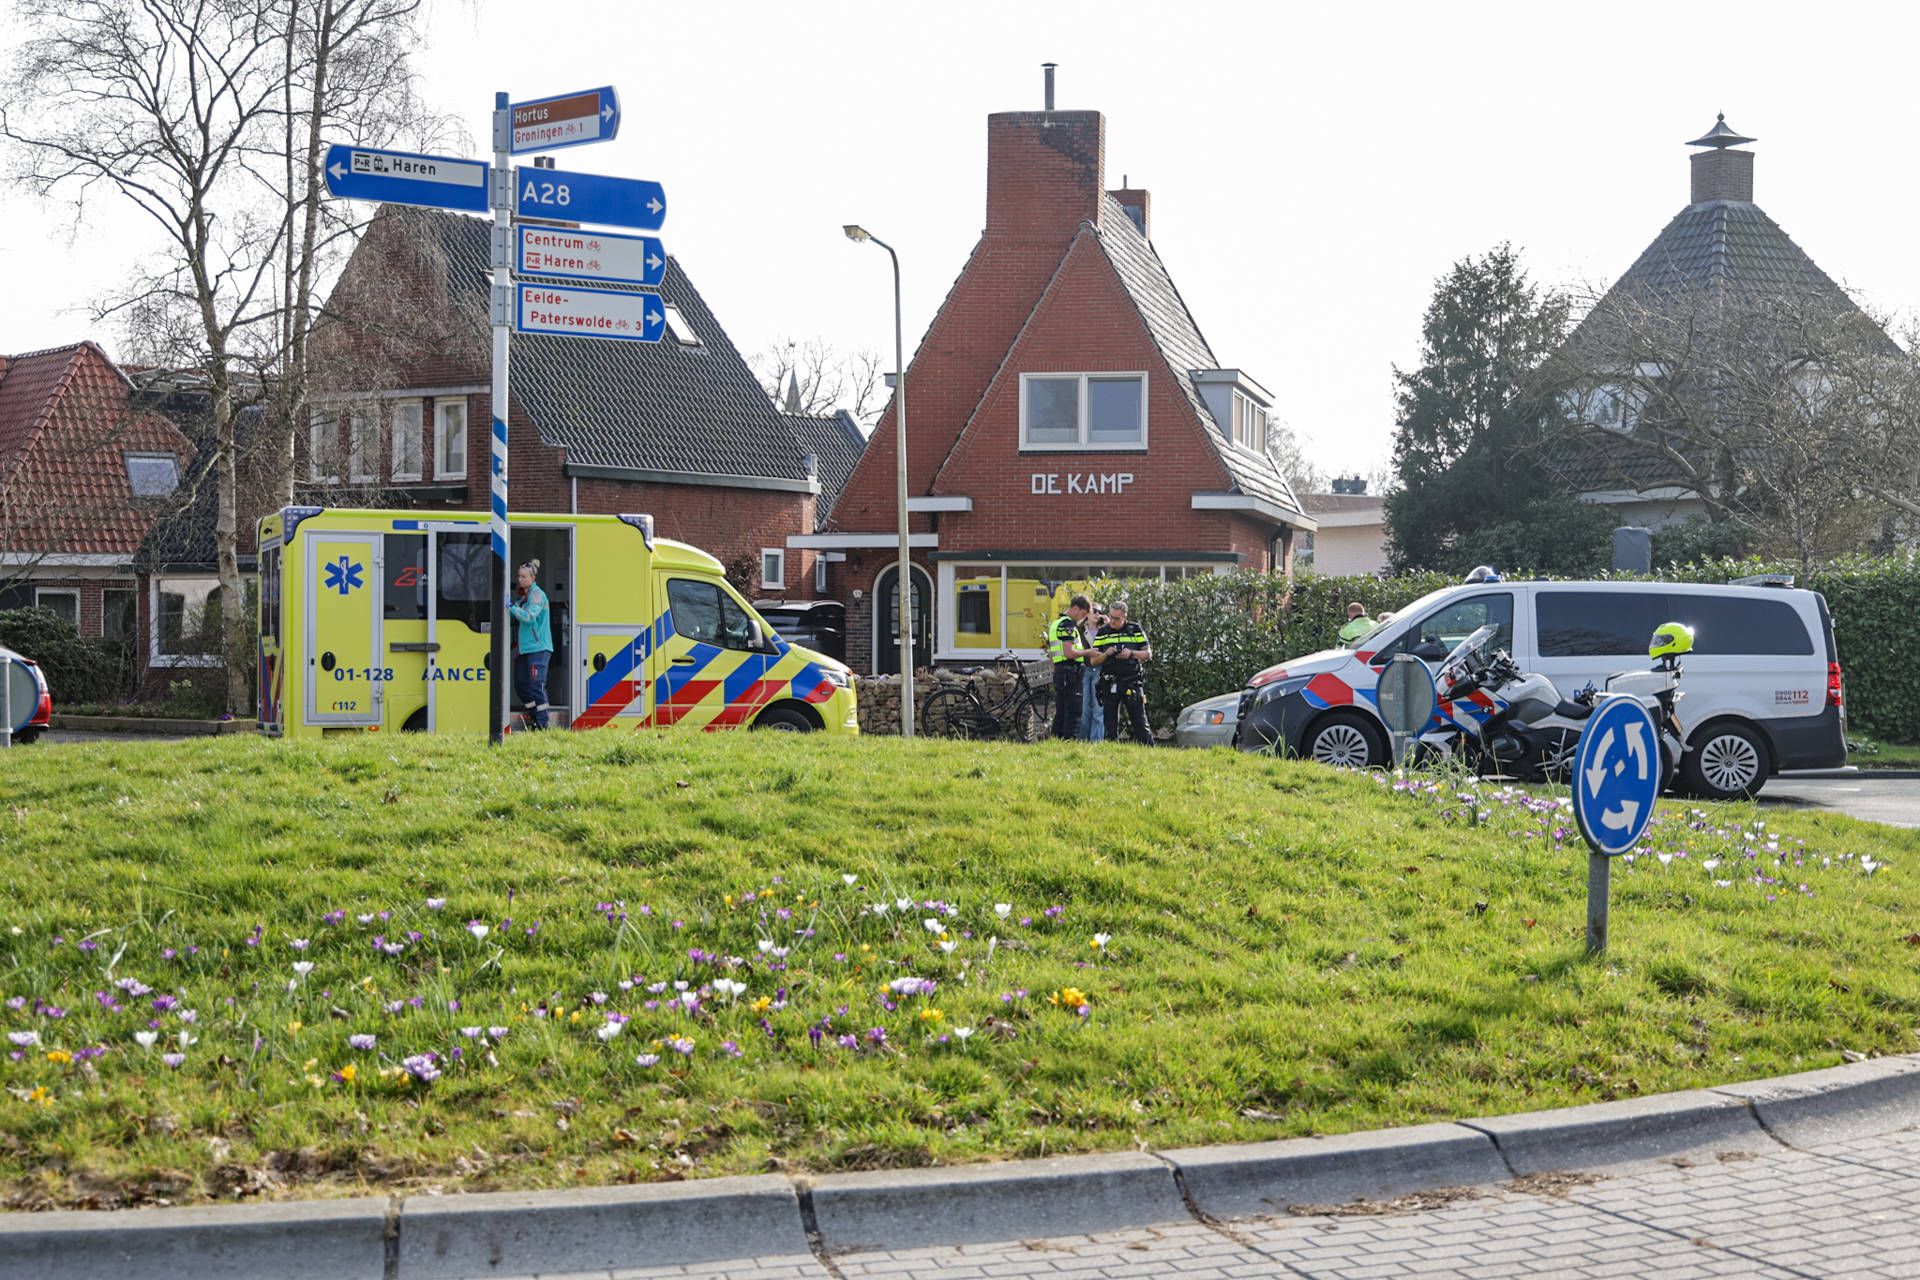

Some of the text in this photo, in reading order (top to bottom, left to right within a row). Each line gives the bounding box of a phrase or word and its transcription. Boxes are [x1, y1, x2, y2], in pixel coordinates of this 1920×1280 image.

[514, 108, 549, 124] Hortus
[515, 126, 563, 142] Groningen
[393, 158, 436, 175] Haren
[522, 181, 570, 206] A28
[525, 232, 584, 249] Centrum
[544, 254, 584, 269] Haren
[525, 290, 568, 305] Eelde-
[531, 311, 641, 331] Paterswolde 3
[1031, 473, 1134, 495] DE KAMP
[334, 668, 394, 681] 01-128
[1792, 690, 1809, 699] 112
[338, 701, 357, 711] 112
